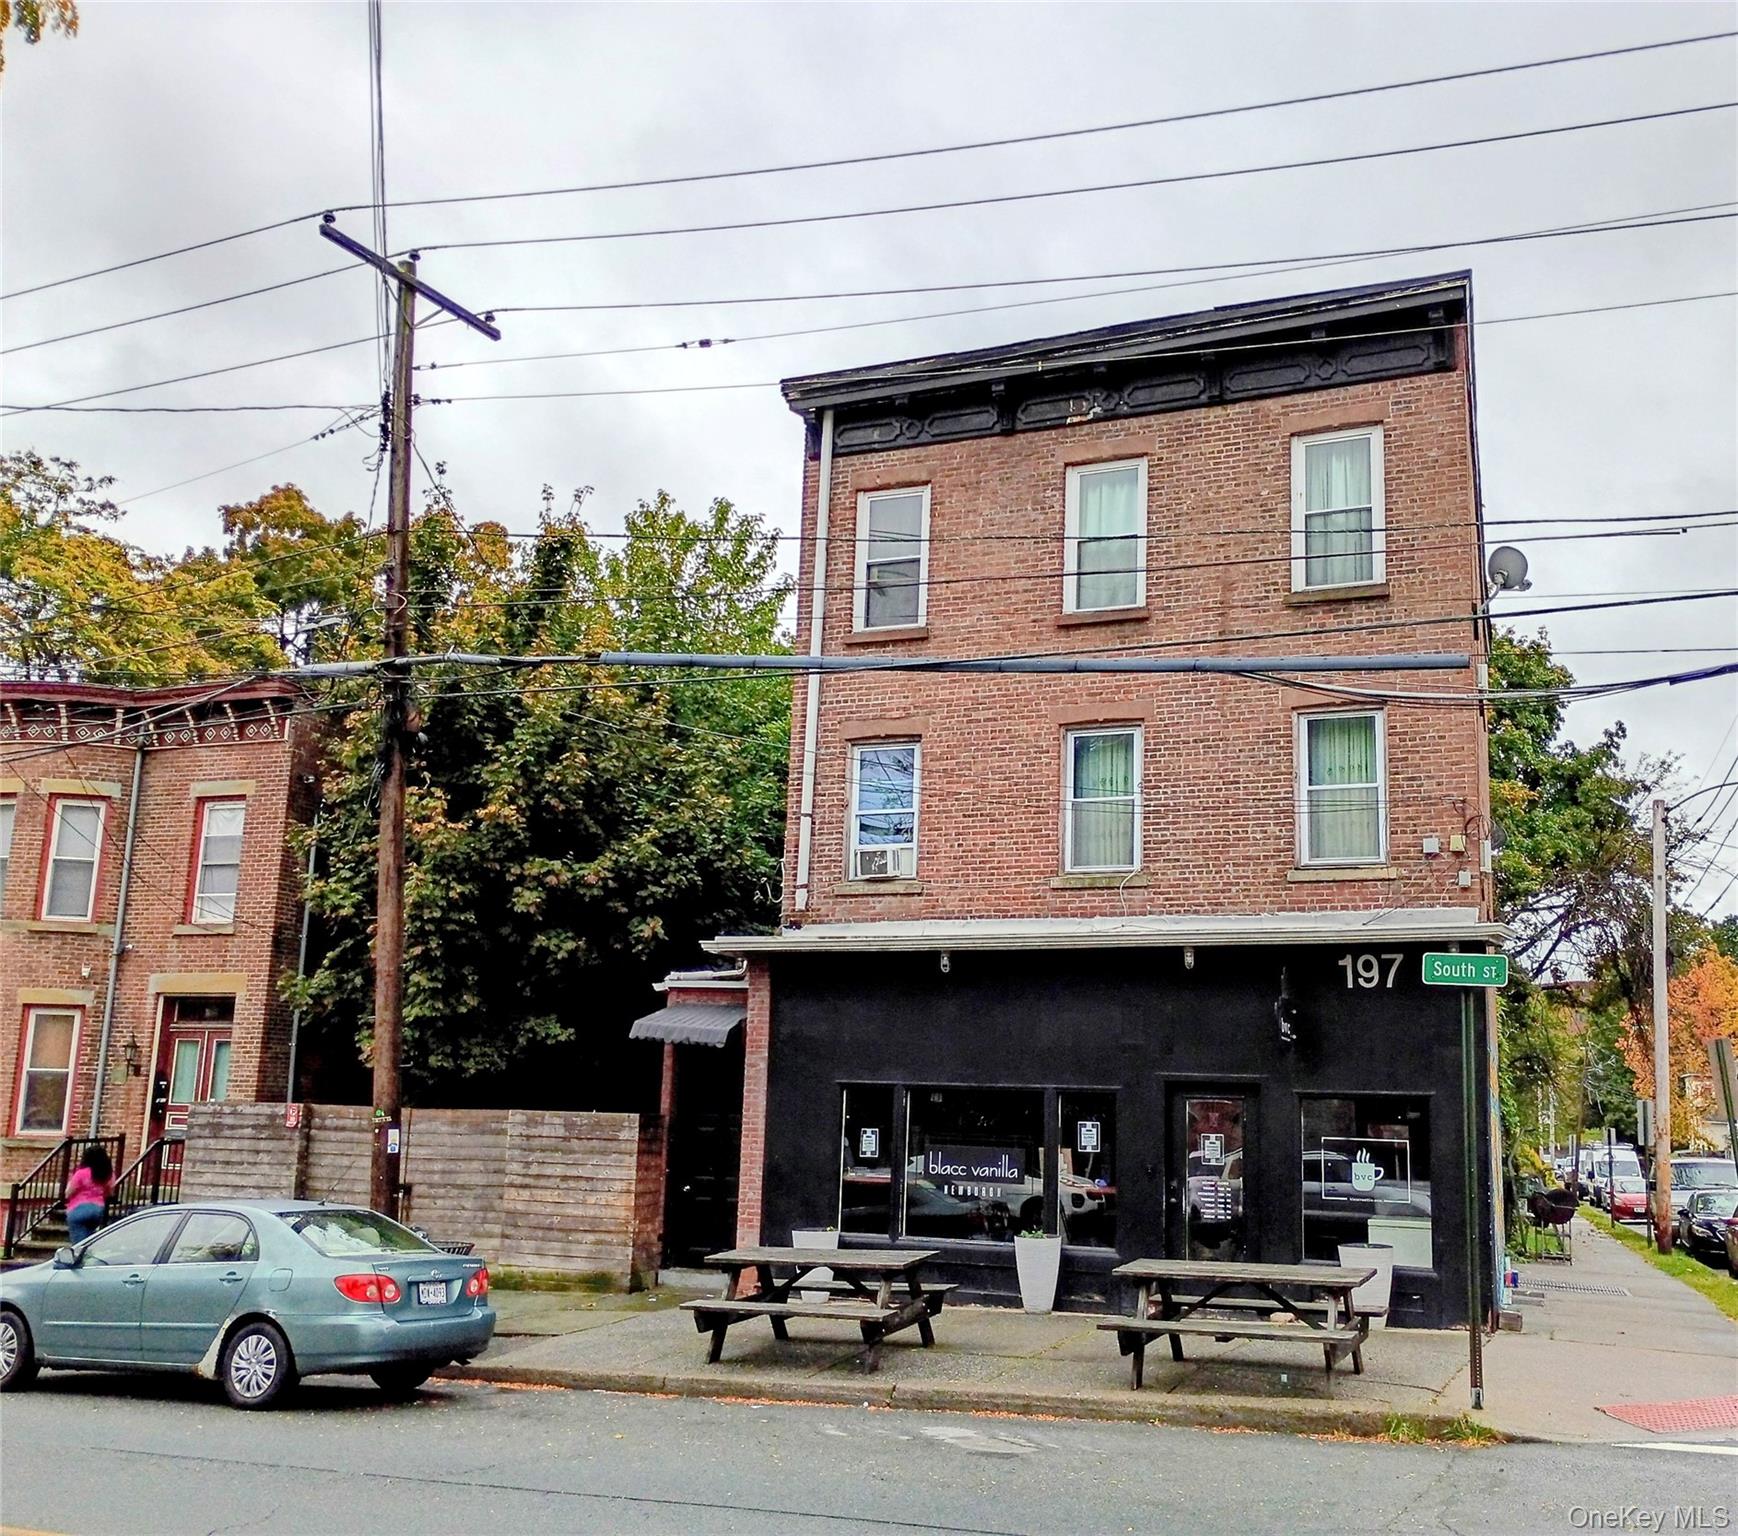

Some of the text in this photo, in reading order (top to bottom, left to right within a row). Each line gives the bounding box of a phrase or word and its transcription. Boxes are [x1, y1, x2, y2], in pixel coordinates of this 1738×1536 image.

[1338, 953, 1404, 989] 197
[1433, 961, 1476, 978] South
[929, 1151, 1018, 1179] blacc vanilla
[1354, 1172, 1373, 1181] bvc
